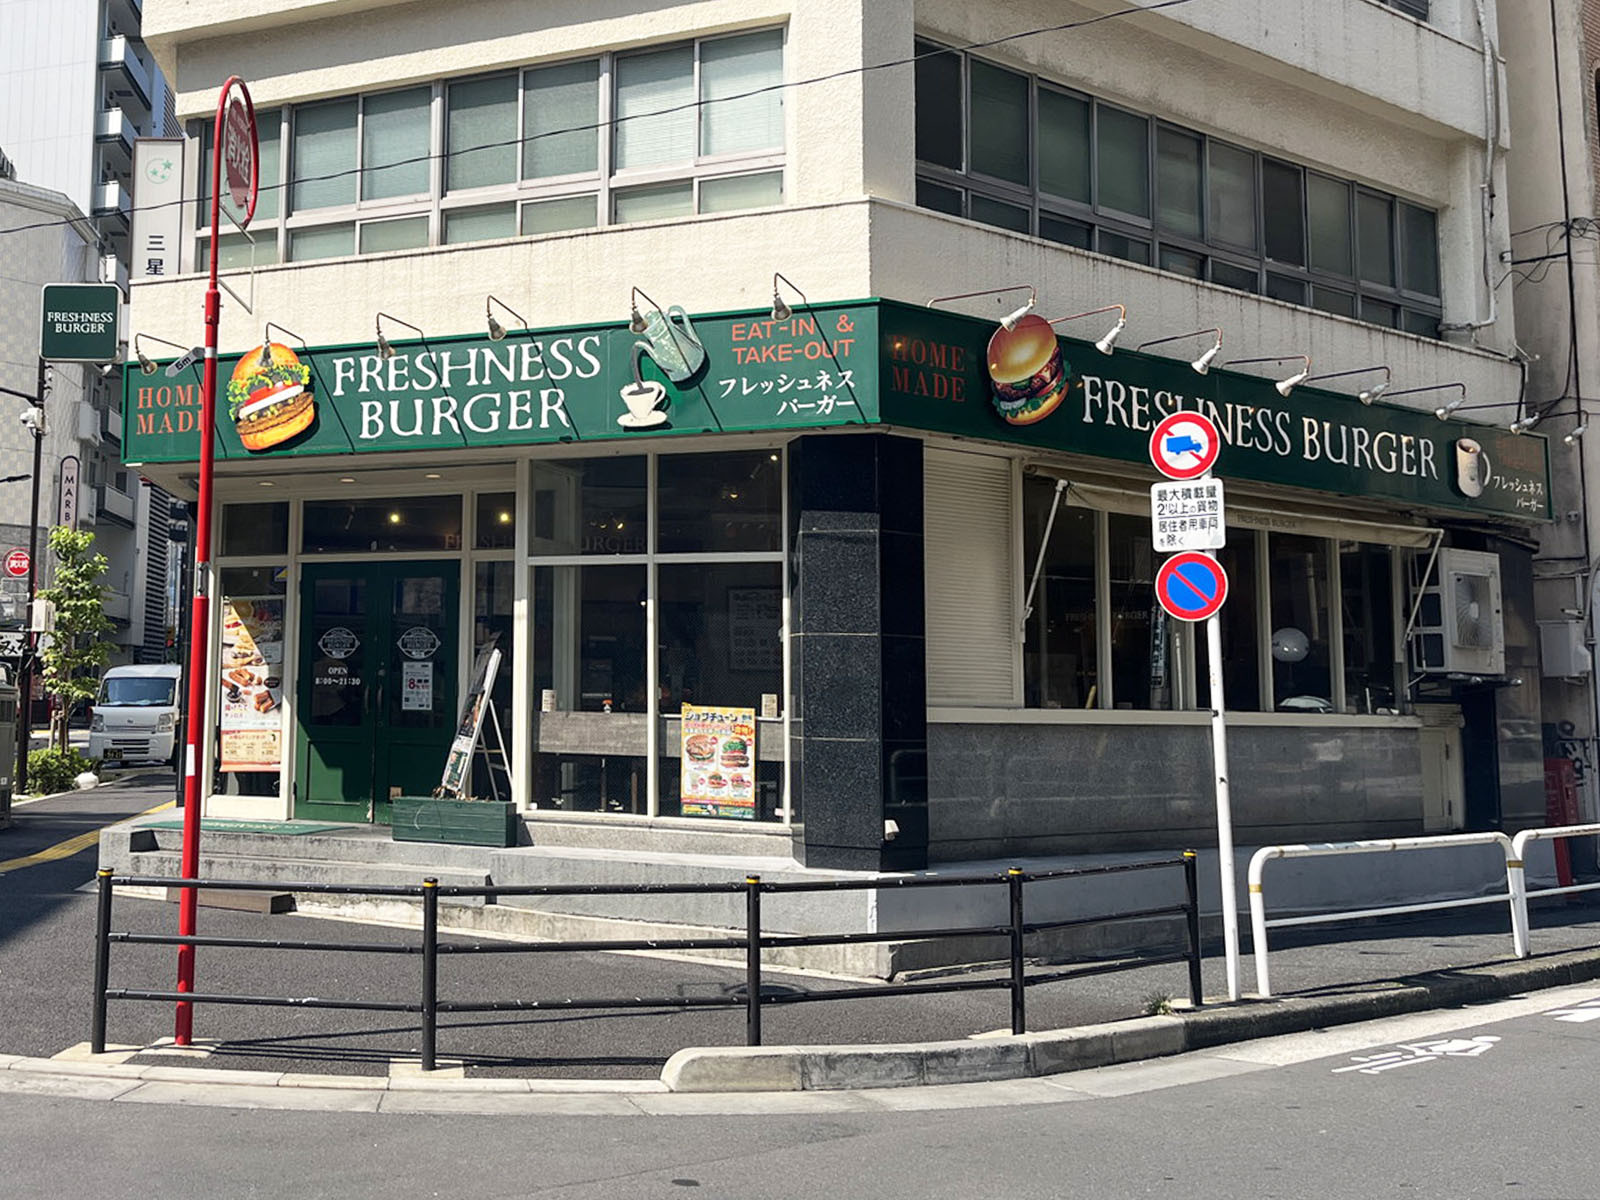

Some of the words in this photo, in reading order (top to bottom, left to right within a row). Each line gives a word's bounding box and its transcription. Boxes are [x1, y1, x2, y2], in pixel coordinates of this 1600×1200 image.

[47, 311, 114, 323] FRESHNESS
[55, 323, 105, 334] BURGER
[732, 318, 816, 342] EAT-IN
[836, 314, 855, 333] &
[333, 335, 601, 397] FRESHNESS
[732, 339, 856, 365] TAKE-OUT
[889, 335, 966, 372] HOME
[718, 370, 856, 398] フレッシュネス
[891, 365, 966, 402] MADE
[360, 388, 570, 439] BURGER
[775, 394, 856, 416] バーガー
[1302, 416, 1439, 480] BURGER
[1493, 475, 1544, 496] フレッシュネス
[327, 666, 348, 676] OPEN
